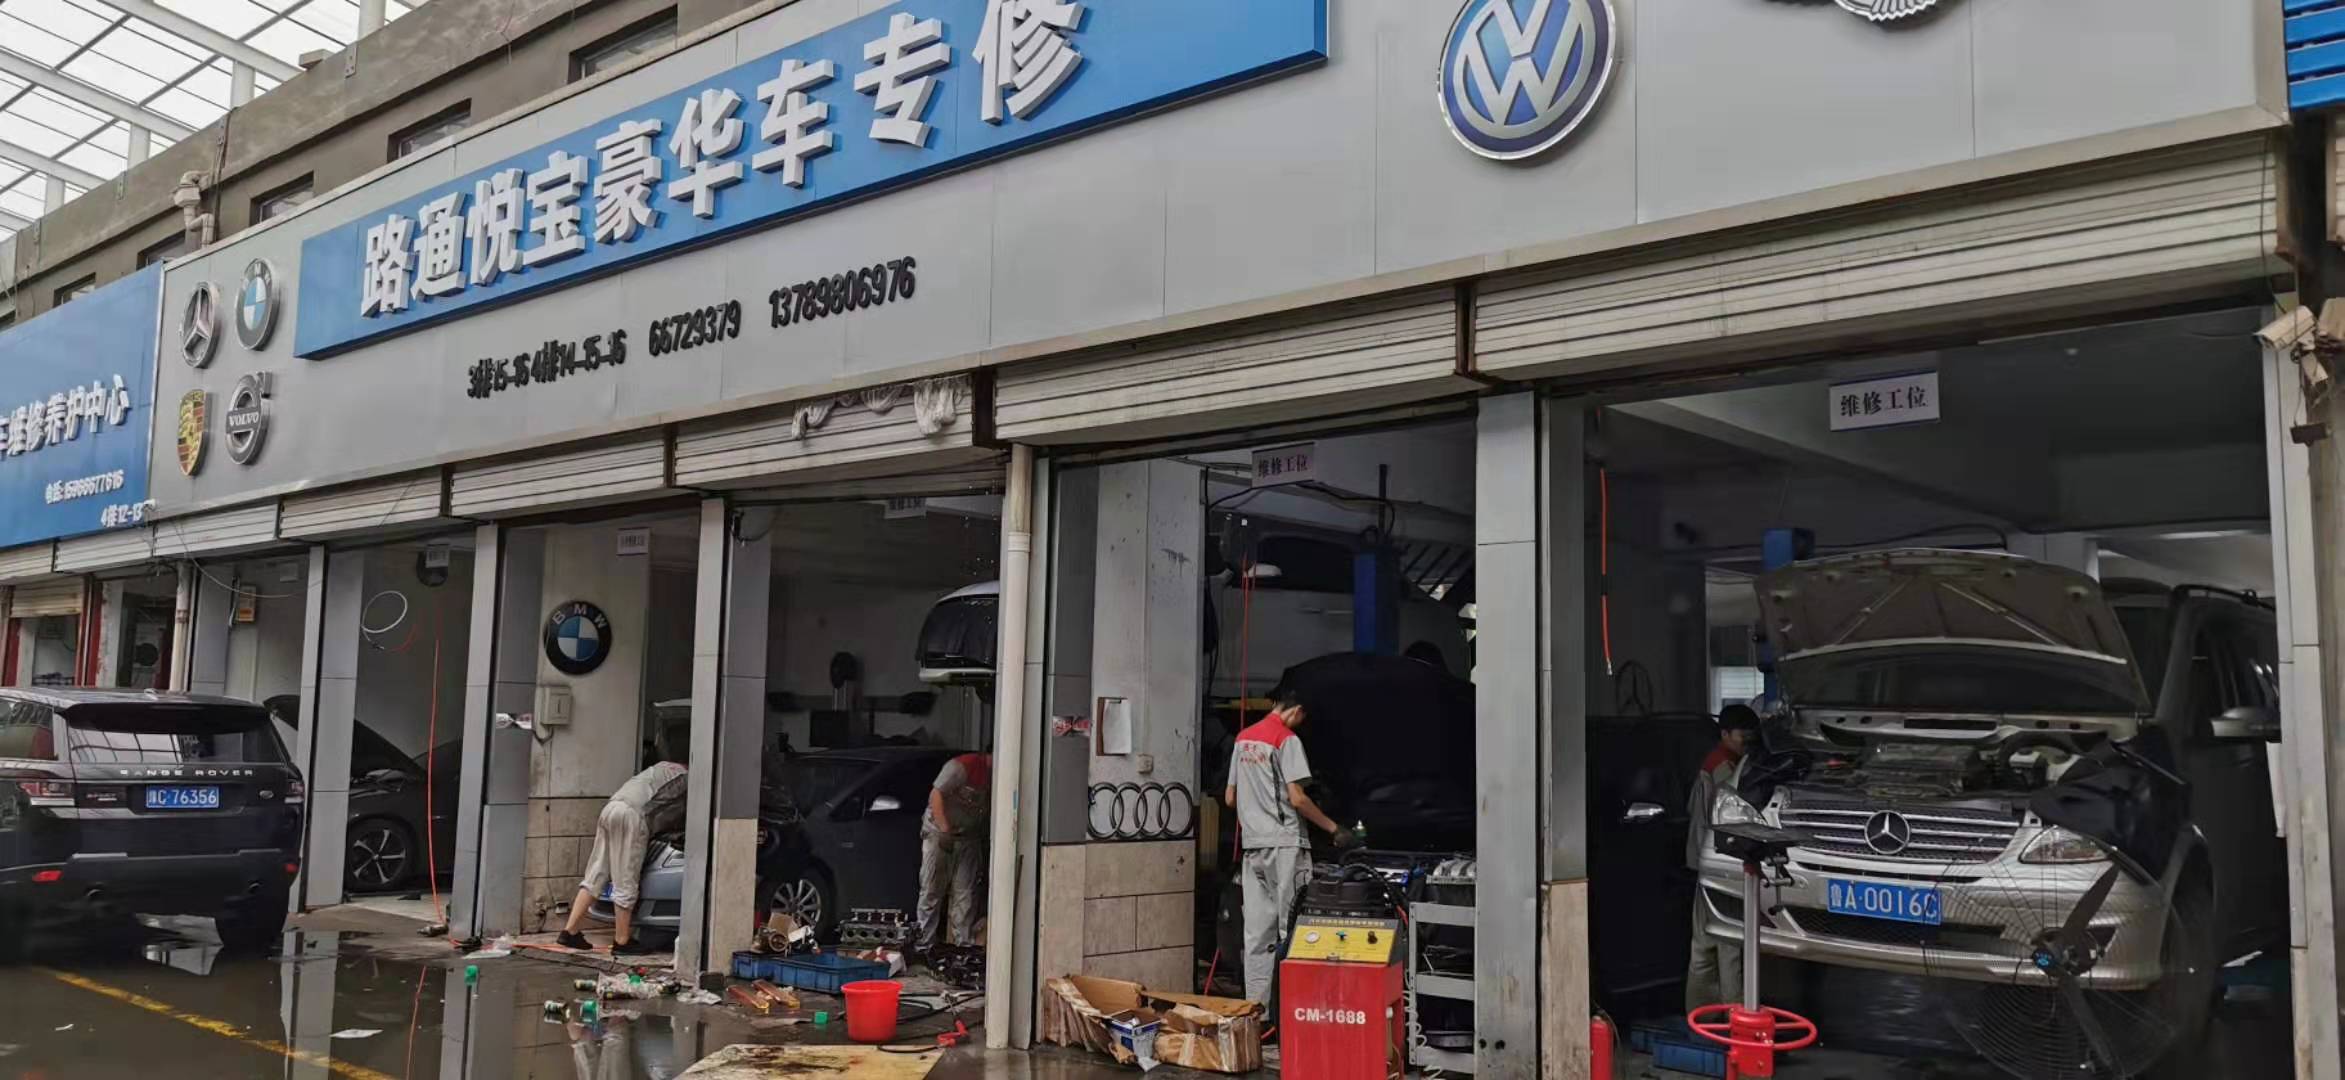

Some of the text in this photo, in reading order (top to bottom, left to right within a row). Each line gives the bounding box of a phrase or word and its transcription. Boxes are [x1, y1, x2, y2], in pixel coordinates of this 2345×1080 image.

[361, 0, 1087, 318] 路通悦宝豪华车专修
[649, 299, 742, 356] 66729379
[768, 256, 916, 328] 13789806976
[1841, 386, 1929, 416] 维修工位
[228, 411, 259, 426] VOLVO
[552, 604, 607, 629] BMW
[195, 769, 254, 777] ROVER
[1294, 1007, 1367, 1025] CM-1688
